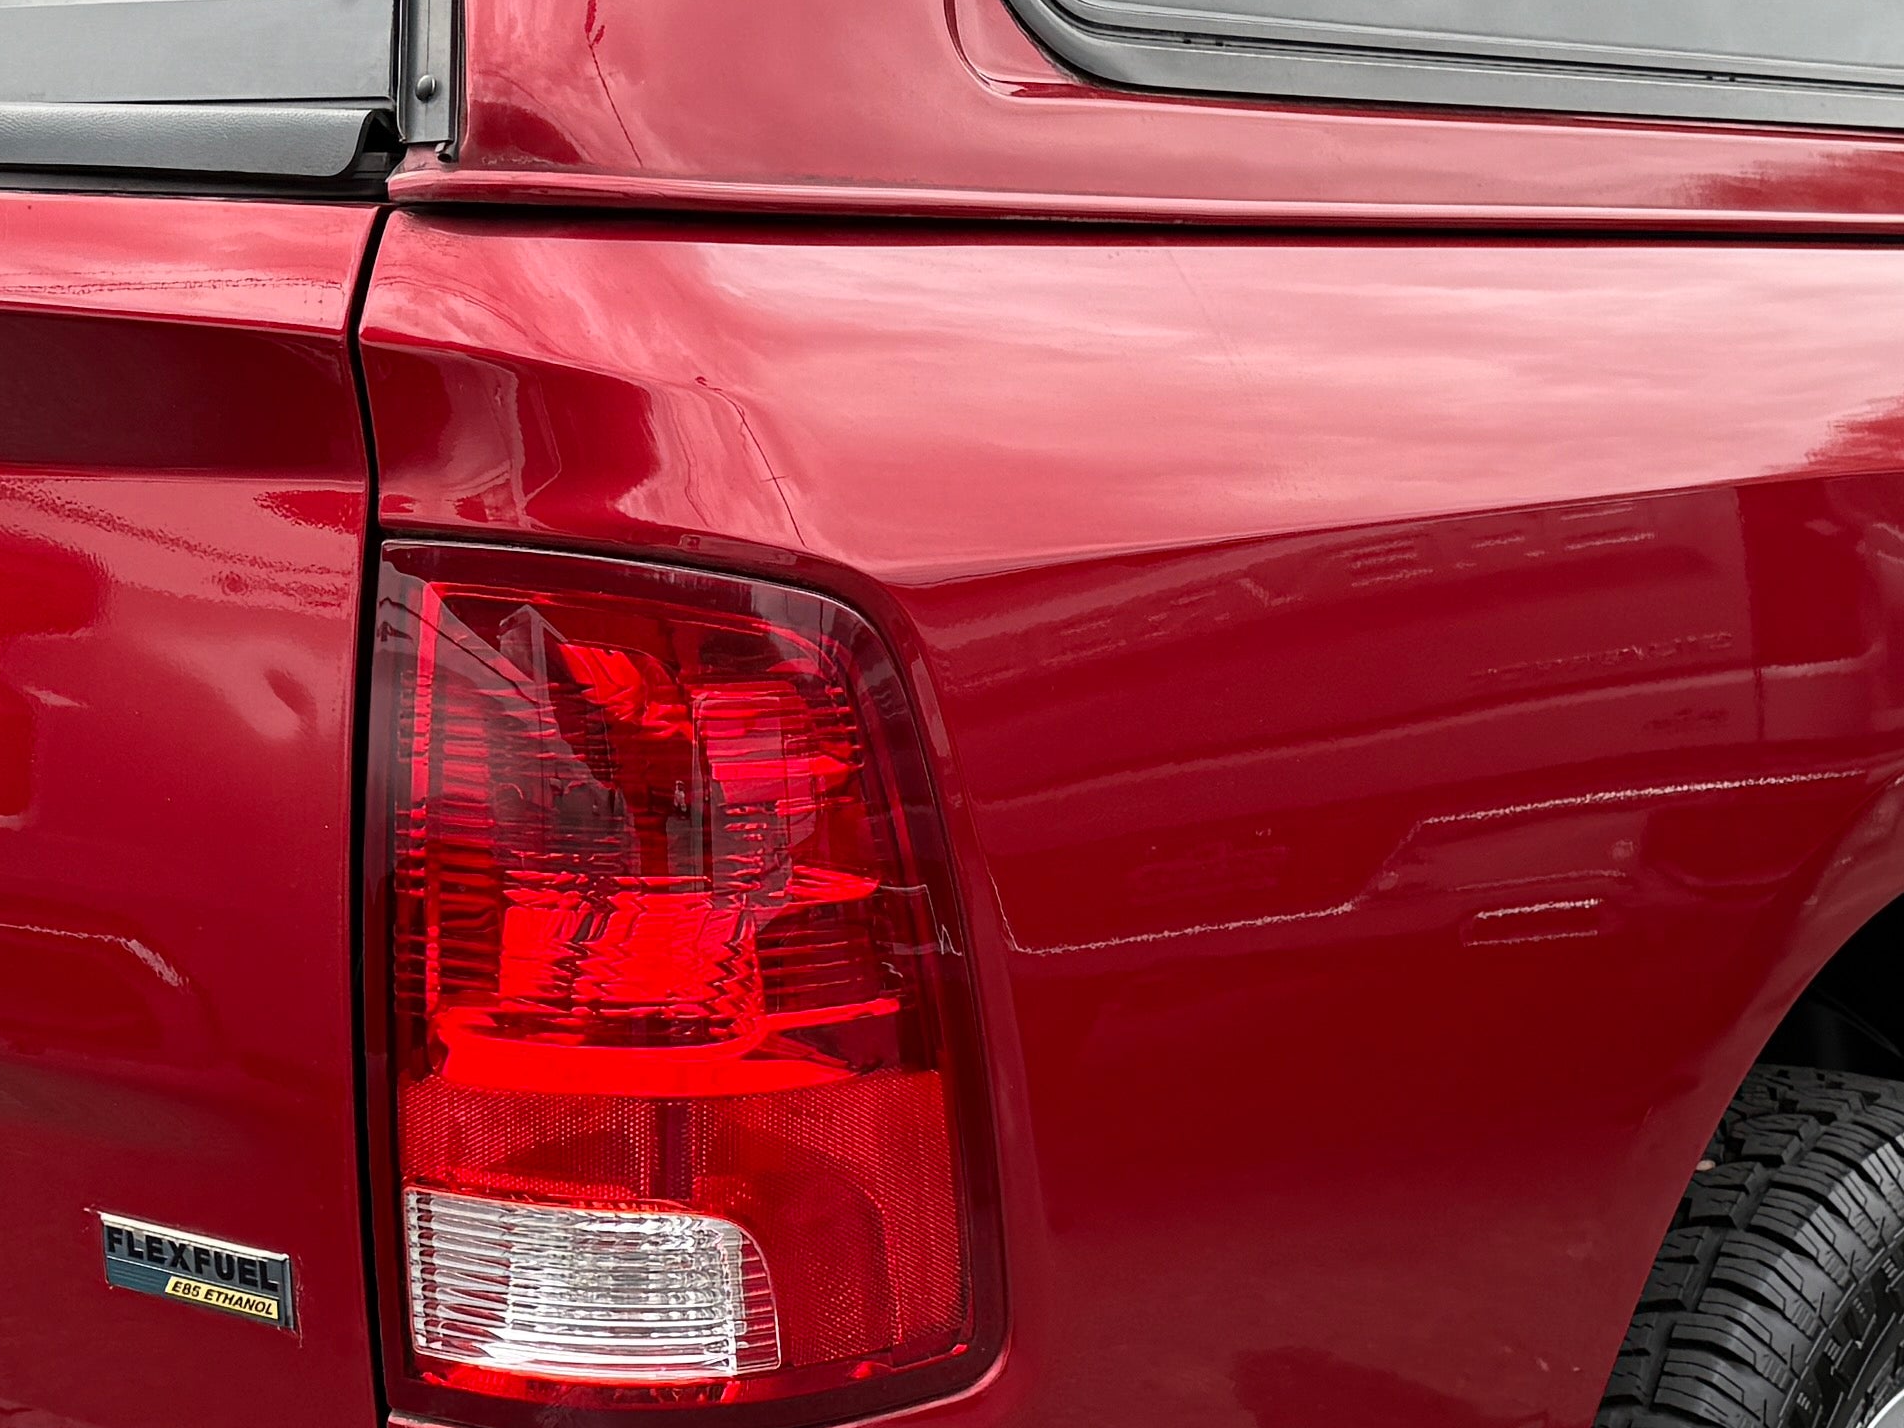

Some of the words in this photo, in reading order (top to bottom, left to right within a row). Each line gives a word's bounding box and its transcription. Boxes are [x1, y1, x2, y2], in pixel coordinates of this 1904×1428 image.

[106, 1225, 279, 1292] FLEXFUEL
[171, 1281, 201, 1297] E85
[204, 1288, 273, 1315] ETHANOL
